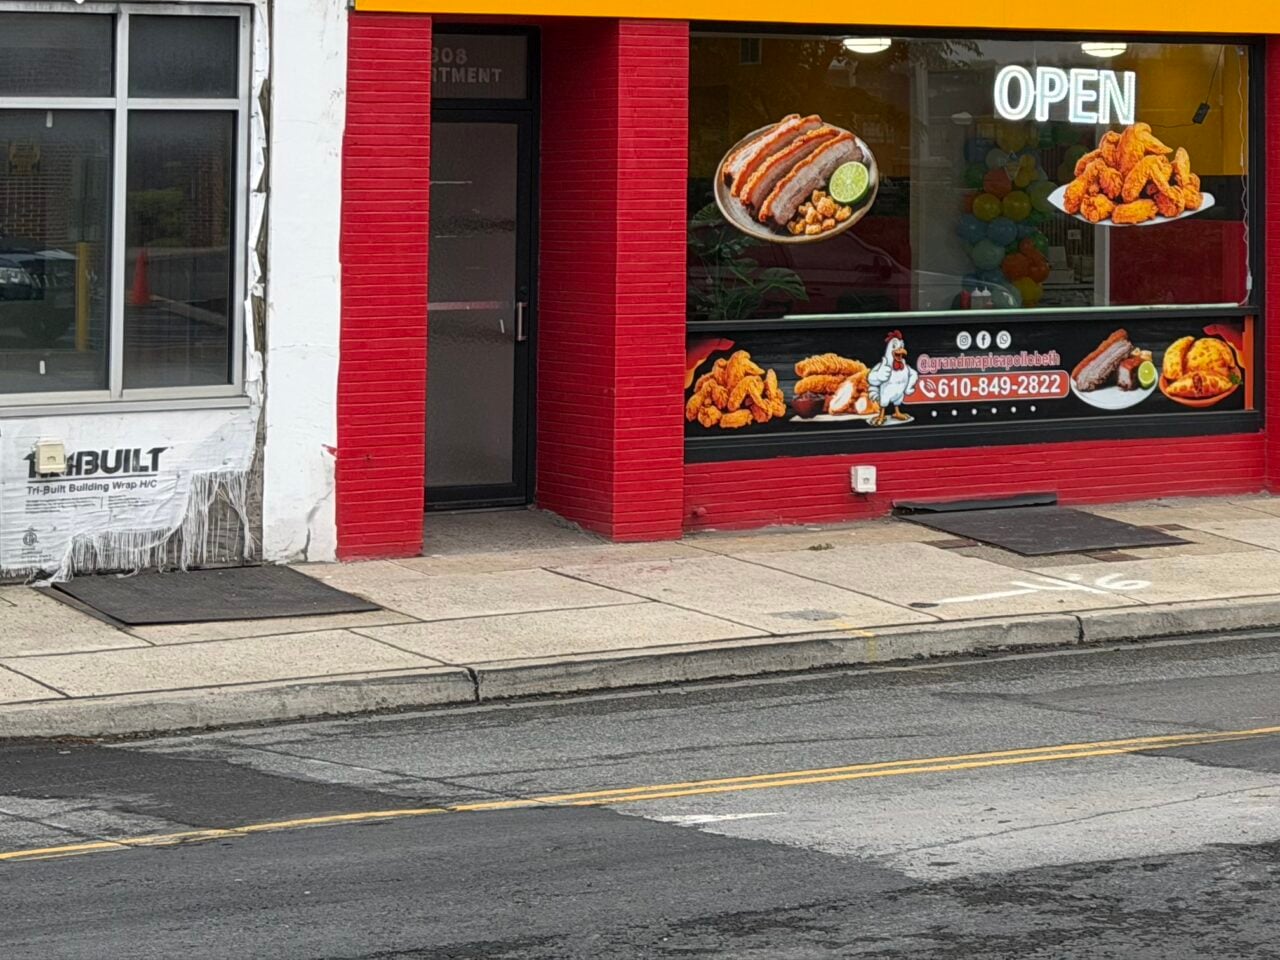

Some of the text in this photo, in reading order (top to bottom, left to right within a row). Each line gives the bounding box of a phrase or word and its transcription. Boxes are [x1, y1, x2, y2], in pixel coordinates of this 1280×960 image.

[994, 65, 1136, 125] OPEN
[937, 374, 1061, 398] 610-849-2822
[26, 479, 158, 496] Tri-Built Building Wrap H/C
